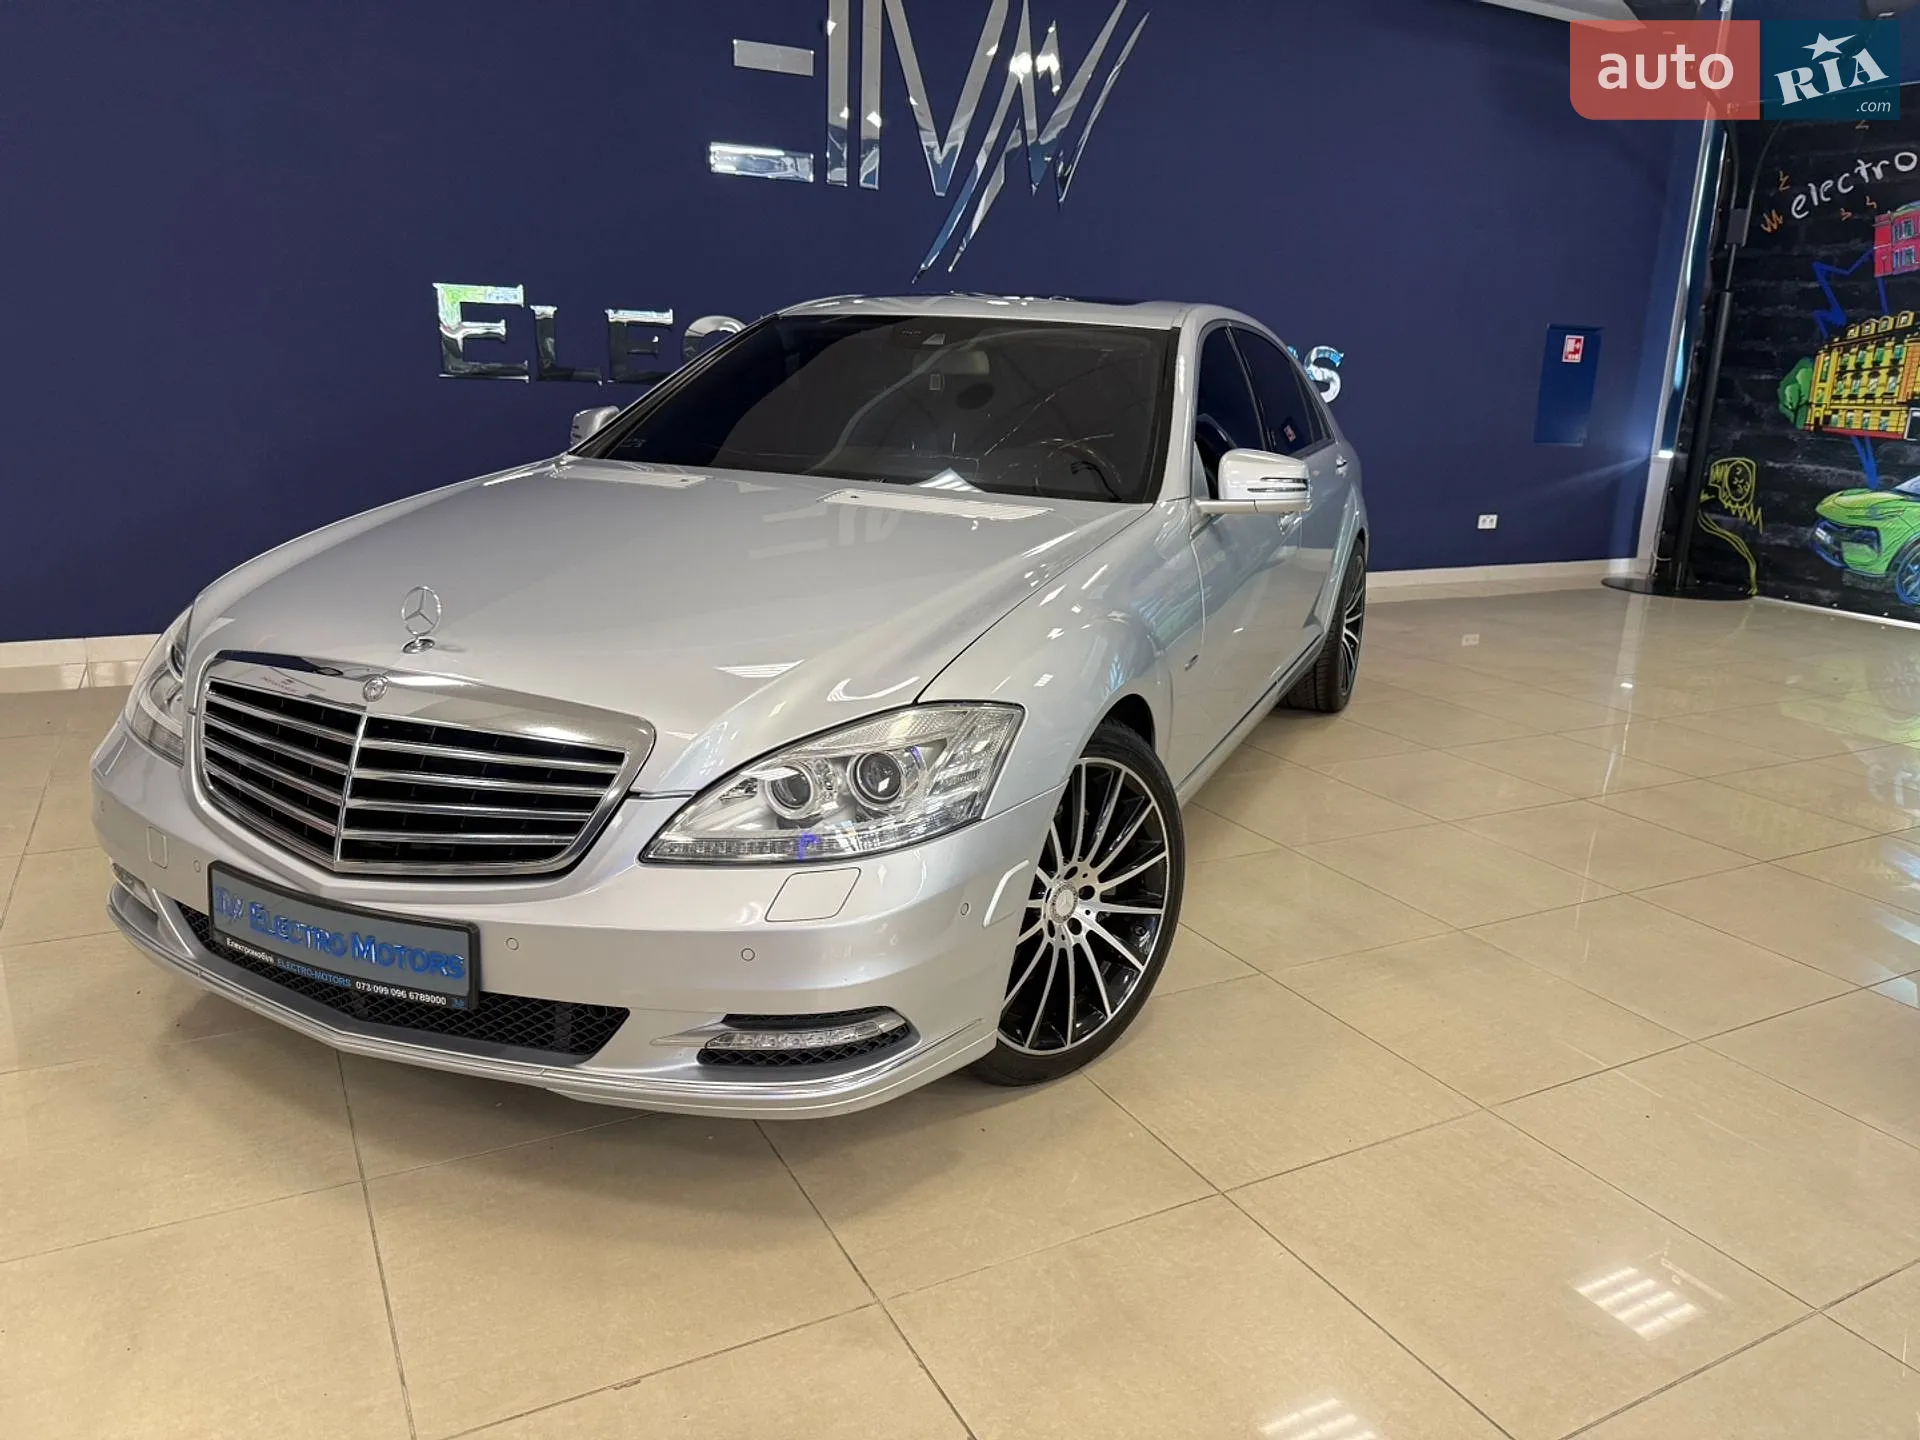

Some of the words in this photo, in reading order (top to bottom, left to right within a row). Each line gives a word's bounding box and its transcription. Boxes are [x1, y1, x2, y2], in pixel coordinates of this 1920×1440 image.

[1791, 151, 1919, 220] electro
[248, 901, 347, 957] ELECTRO
[350, 931, 465, 980] MOTORS
[277, 958, 352, 987] ELECTRO-MOTORS
[409, 991, 447, 1006] 6789000
